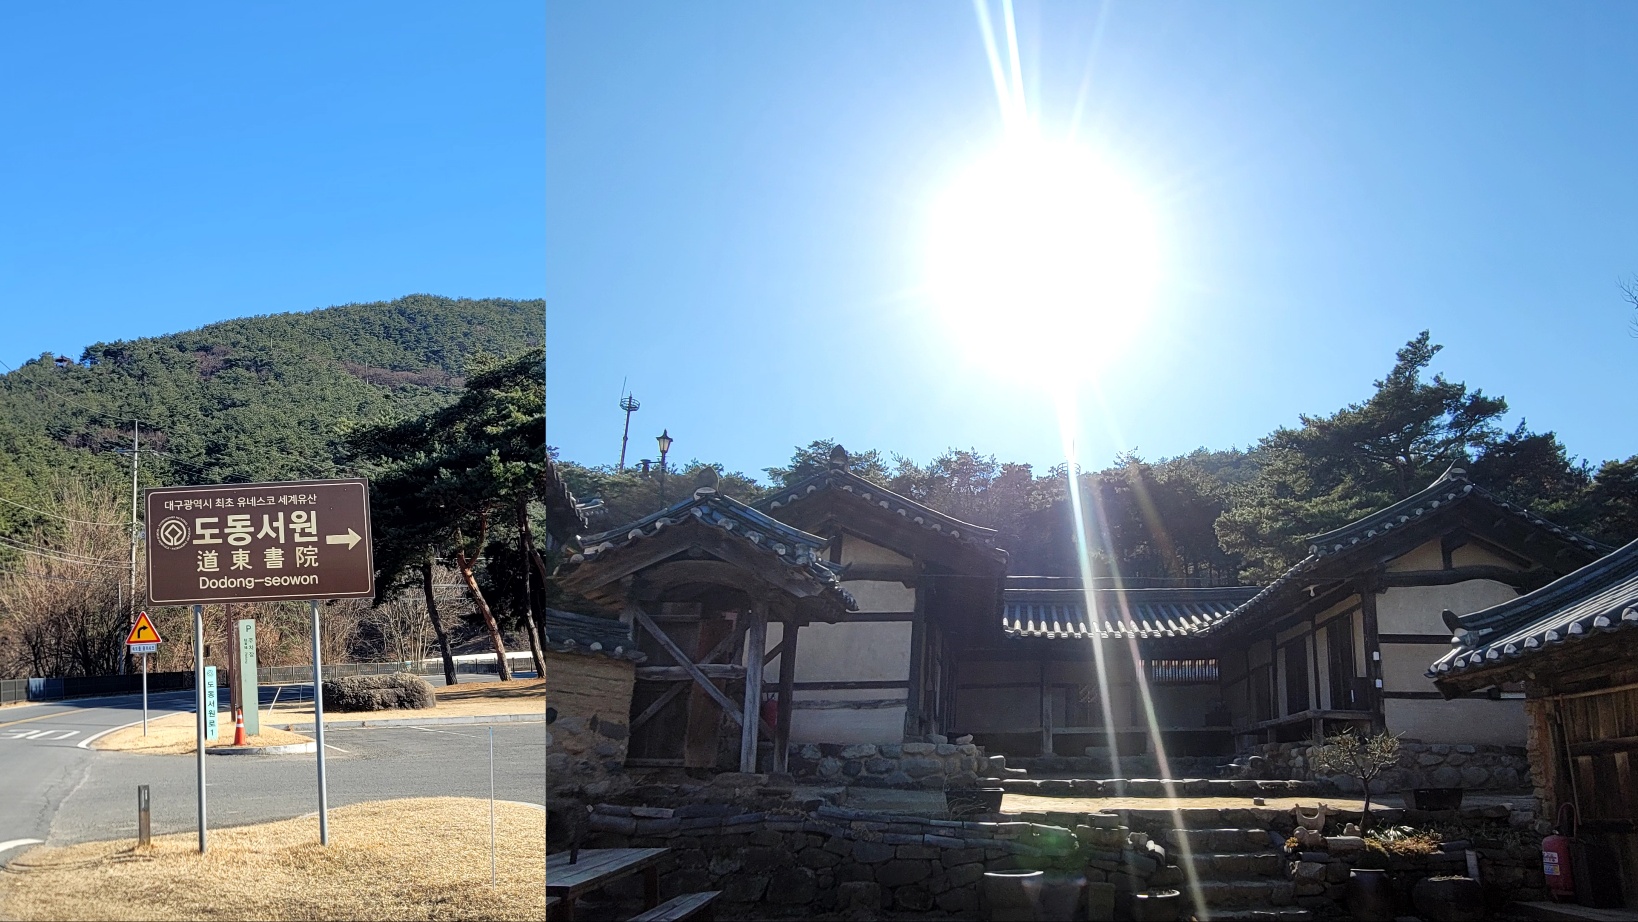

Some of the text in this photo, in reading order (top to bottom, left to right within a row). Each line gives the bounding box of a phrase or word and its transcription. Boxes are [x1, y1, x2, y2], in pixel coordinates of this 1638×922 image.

[164, 494, 317, 511] 대구광역시 최초 유네스코 세계유산
[192, 510, 319, 546] 도동서원
[199, 574, 318, 590] Dodong-seowon
[245, 624, 252, 632] P
[0, 729, 80, 740] 30
